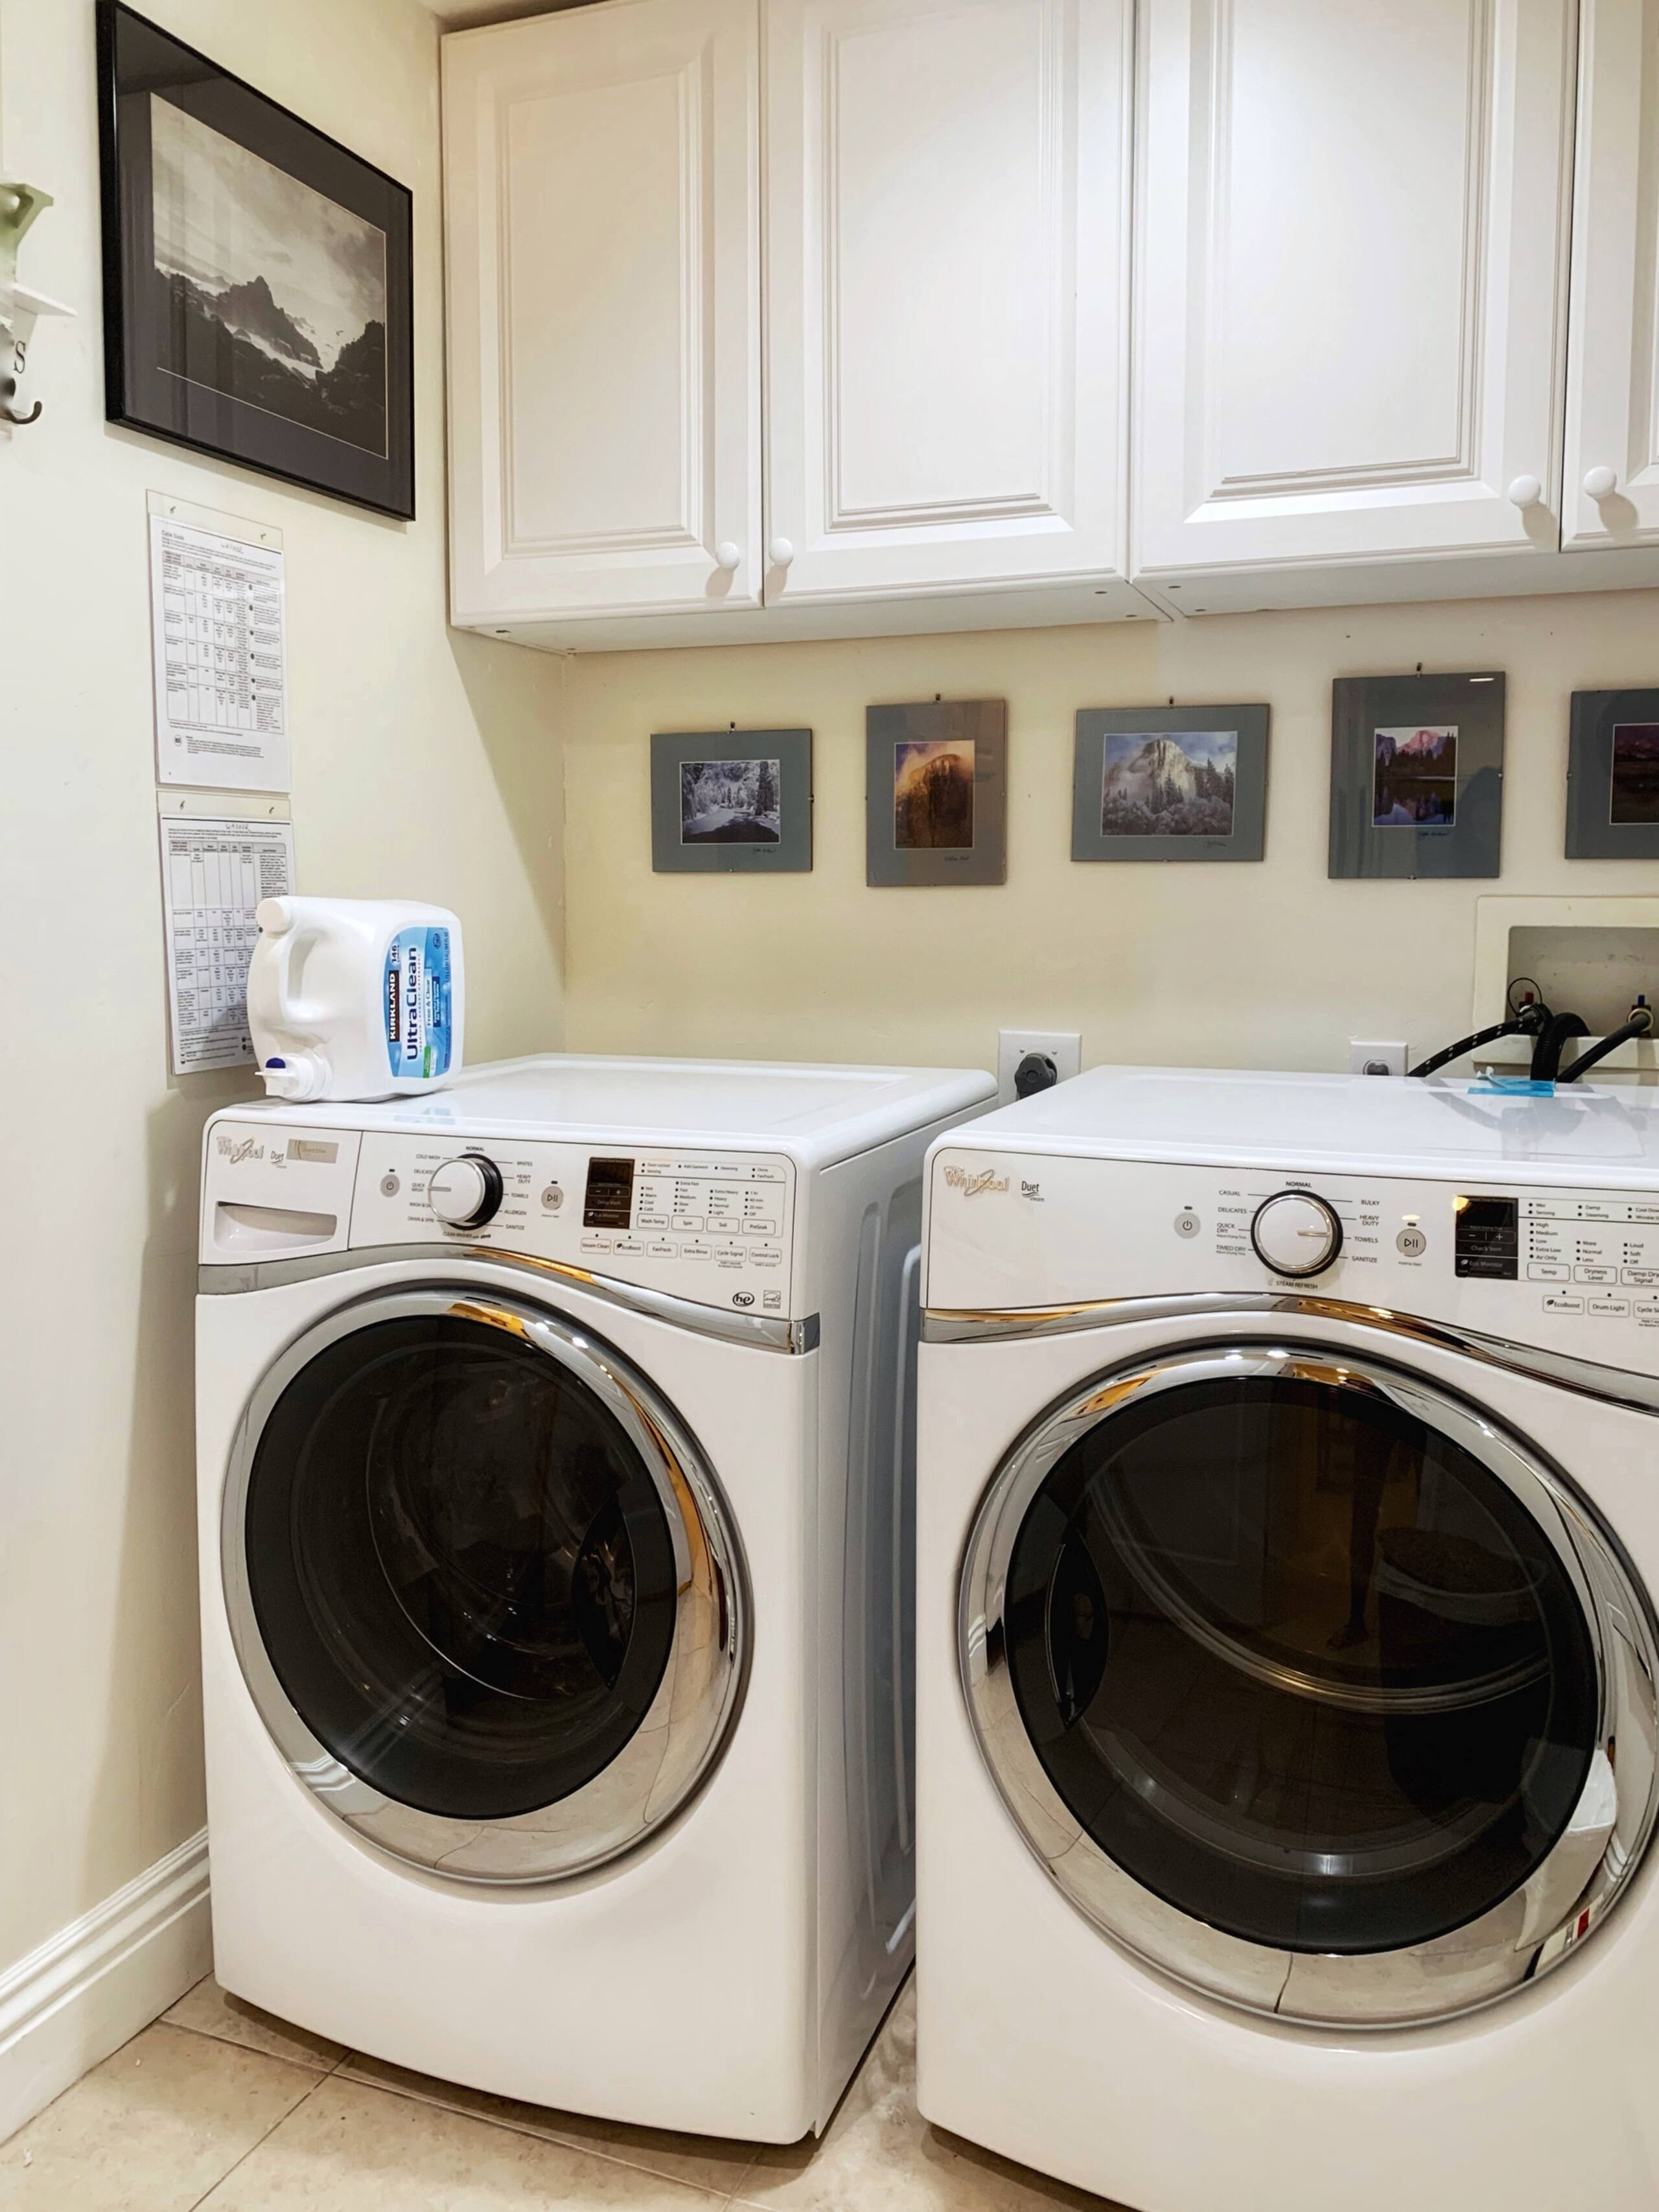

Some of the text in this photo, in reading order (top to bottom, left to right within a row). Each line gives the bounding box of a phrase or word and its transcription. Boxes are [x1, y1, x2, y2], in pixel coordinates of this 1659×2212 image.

[406, 948, 418, 1060] UltraClean
[944, 1166, 1010, 1196] Whirlpool
[1021, 1181, 1039, 1192] Duet
